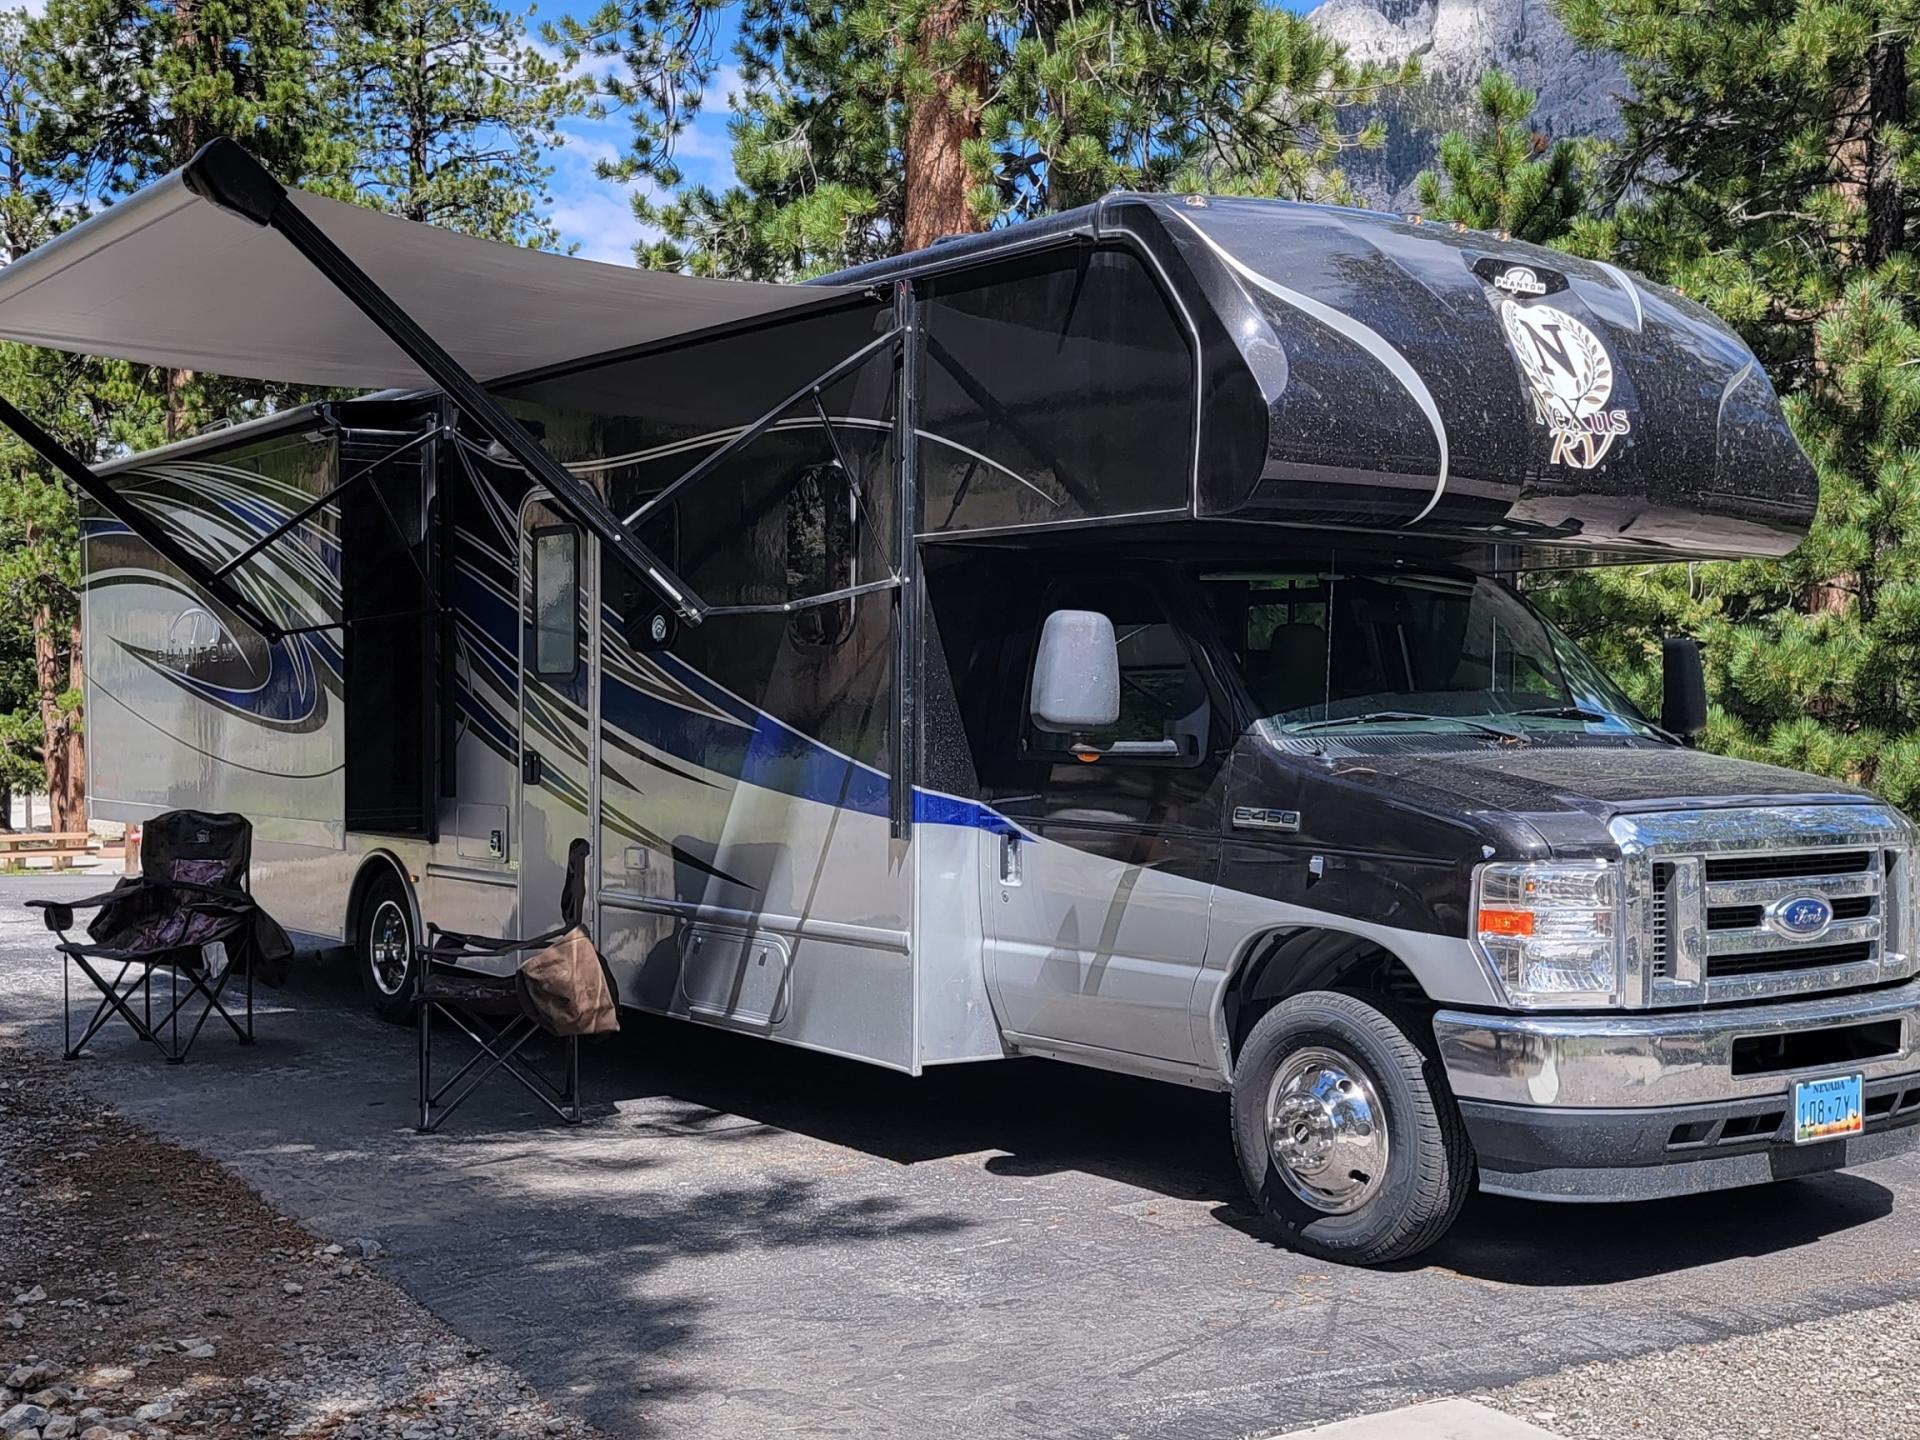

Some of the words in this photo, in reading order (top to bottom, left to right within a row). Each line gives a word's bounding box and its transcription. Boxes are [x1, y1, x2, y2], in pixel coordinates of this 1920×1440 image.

[1496, 278, 1545, 292] PHANTOM
[1520, 319, 1578, 378] N
[1549, 428, 1616, 470] RV
[1794, 905, 1822, 925] Ford
[1812, 1080, 1846, 1095] NEVADA
